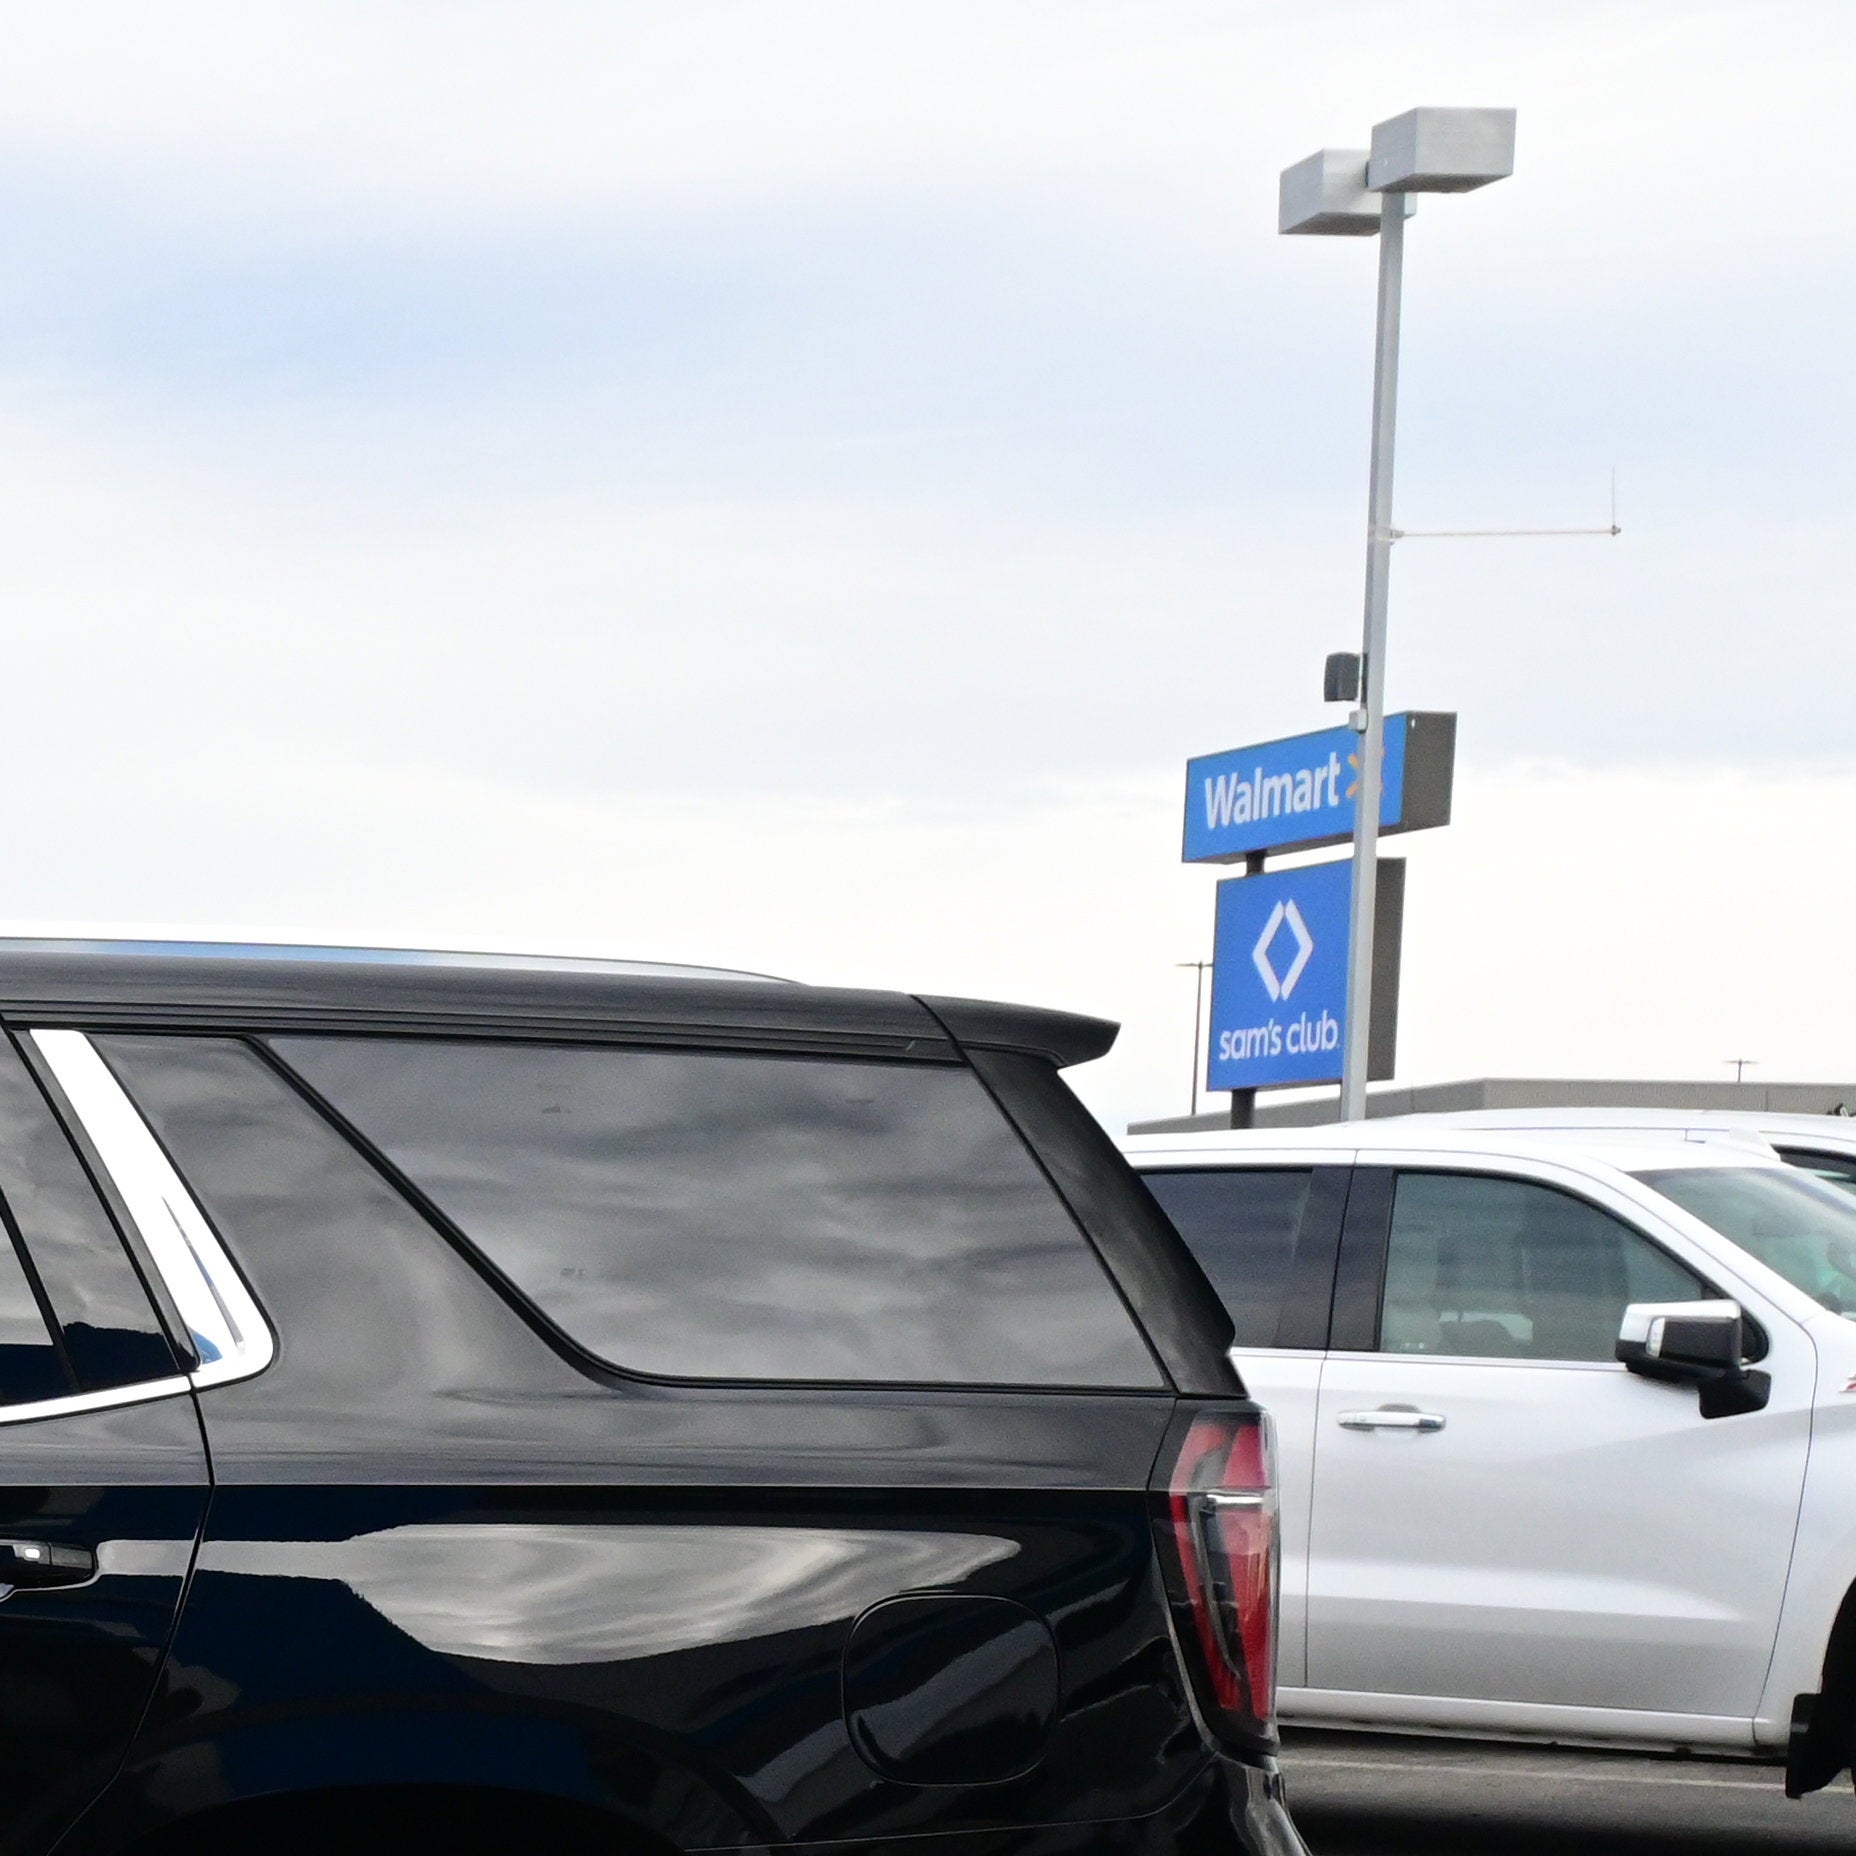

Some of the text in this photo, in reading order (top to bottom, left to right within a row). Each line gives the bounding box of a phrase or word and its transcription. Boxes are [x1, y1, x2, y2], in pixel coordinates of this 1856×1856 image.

[1204, 751, 1342, 830] Walmart
[1219, 1009, 1338, 1060] sam's club
